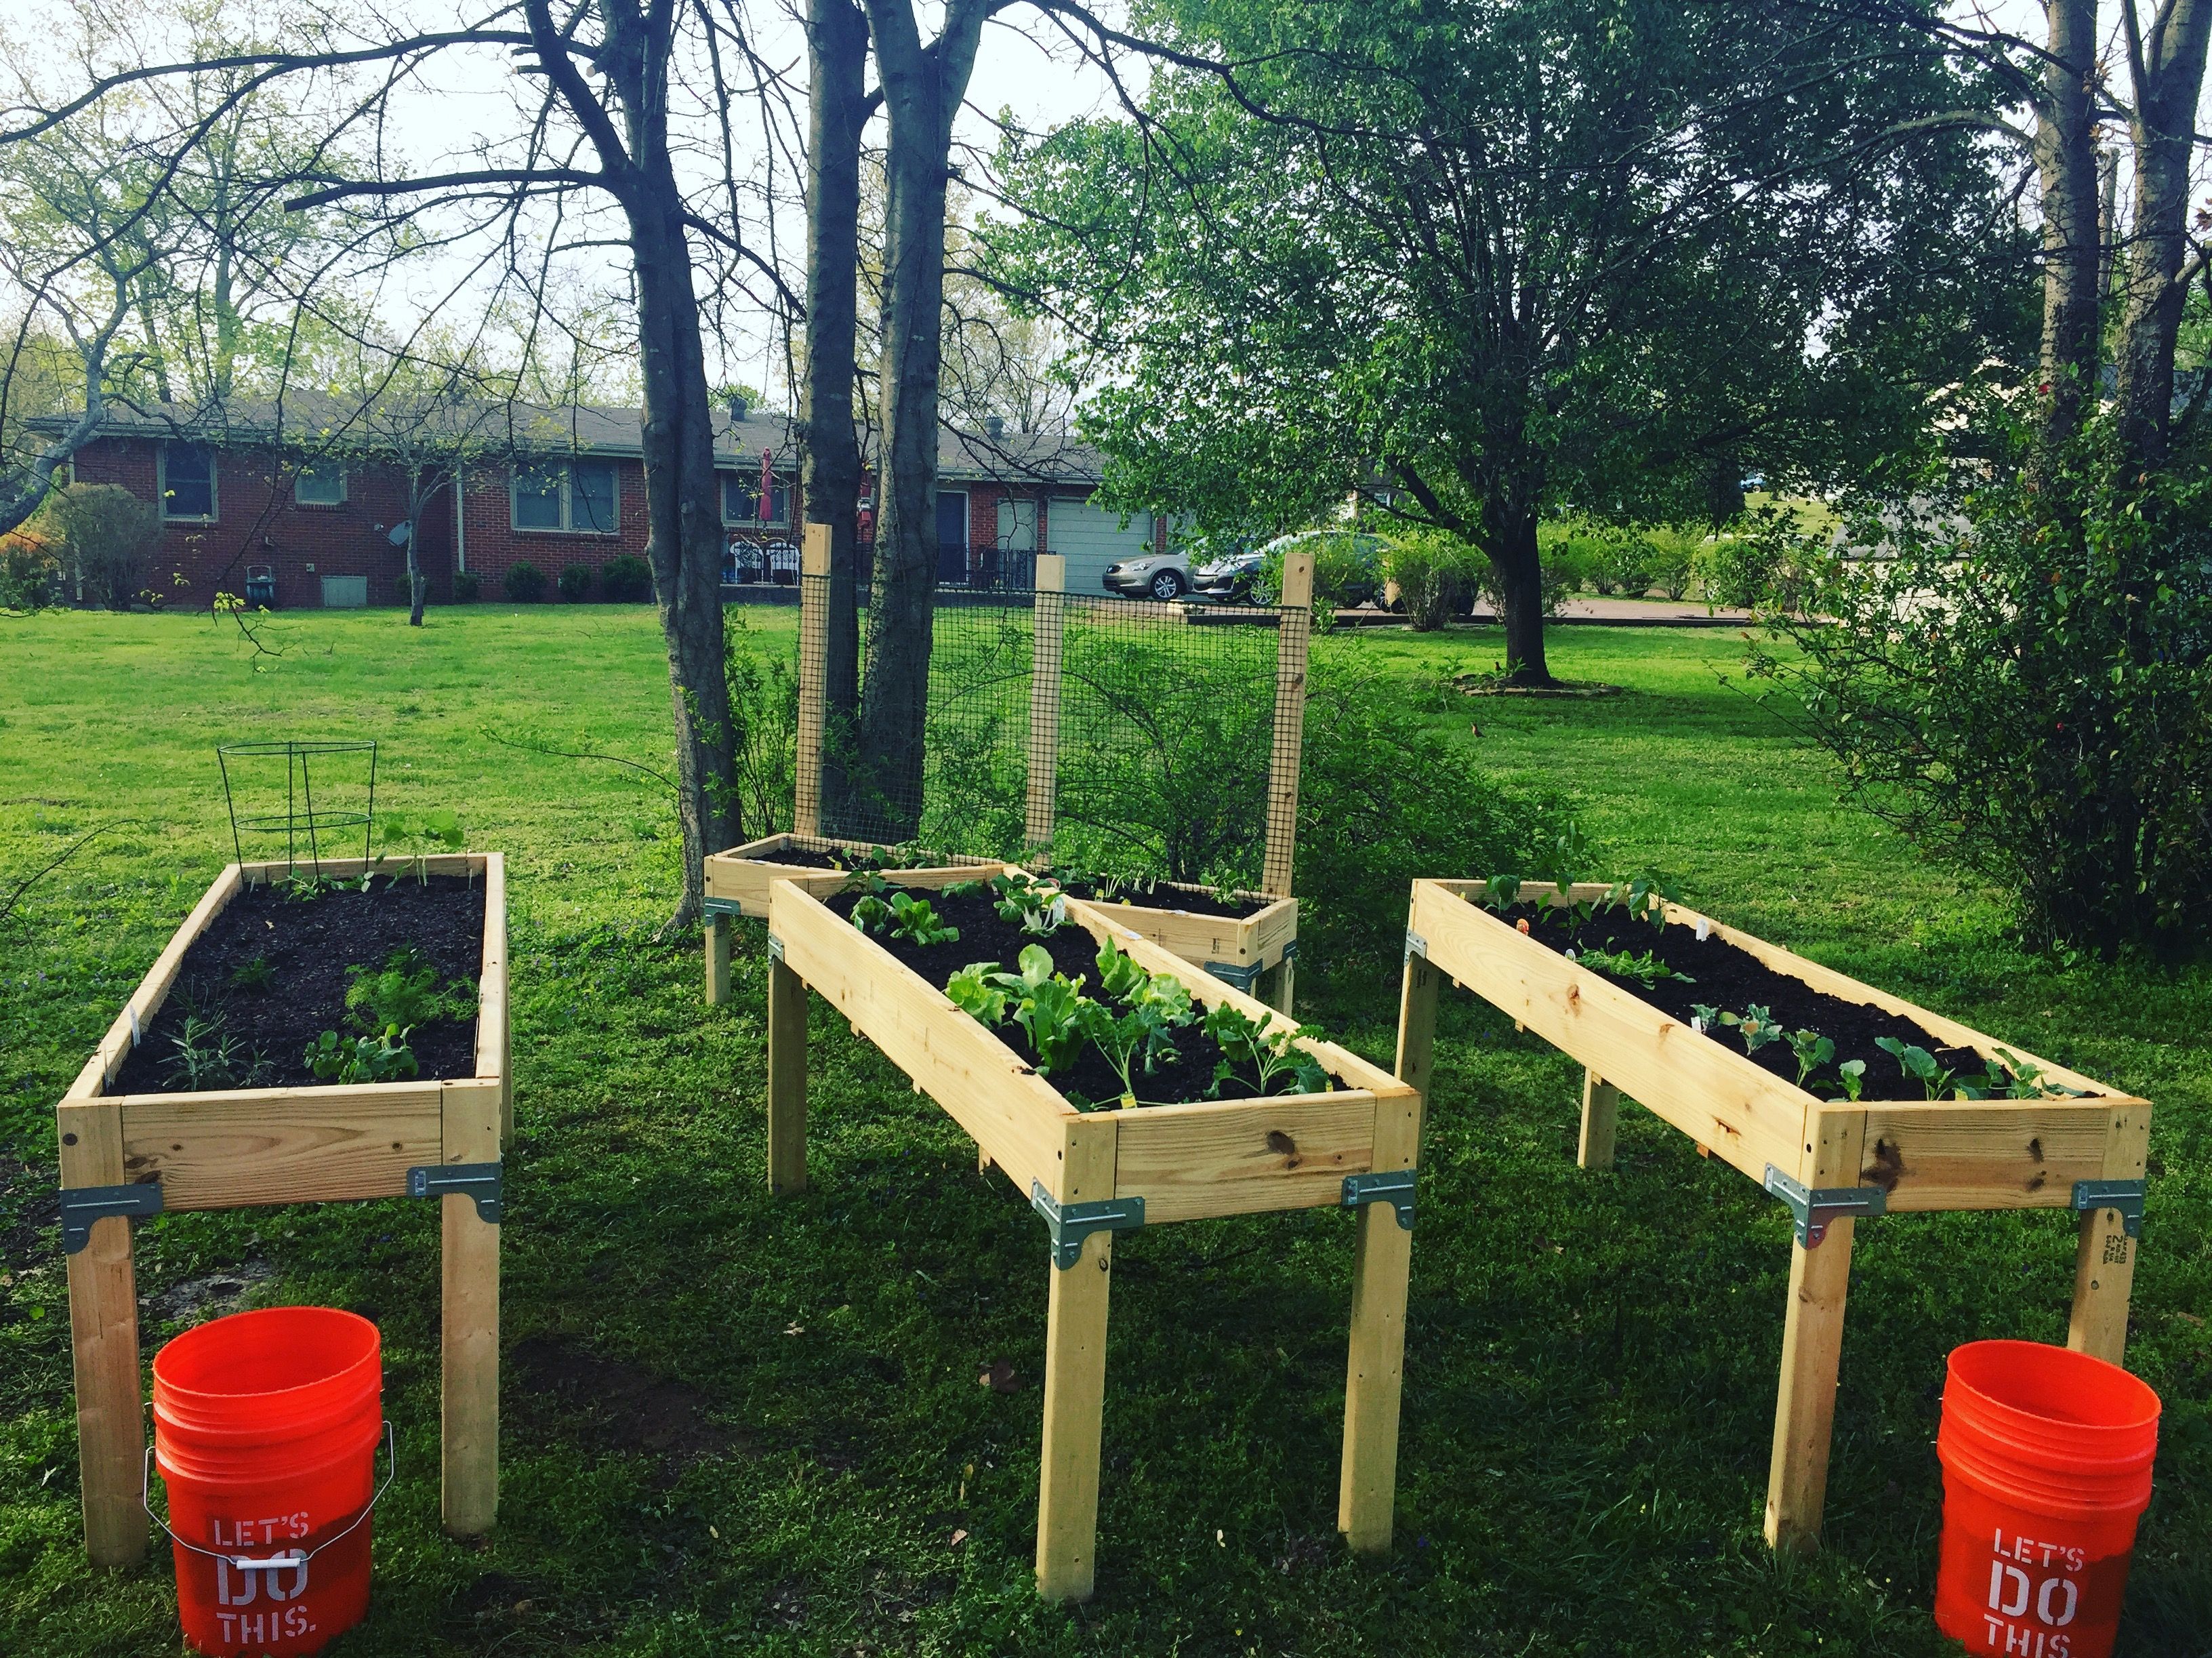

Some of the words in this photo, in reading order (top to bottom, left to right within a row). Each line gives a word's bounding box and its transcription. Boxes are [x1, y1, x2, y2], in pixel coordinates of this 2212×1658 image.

[214, 1512, 308, 1546] LET'S
[1994, 1528, 2085, 1571] LET'S
[217, 1548, 308, 1606] DO
[1988, 1560, 2078, 1627] DO
[216, 1606, 316, 1644] THIS.
[1984, 1613, 2076, 1658] THIS
